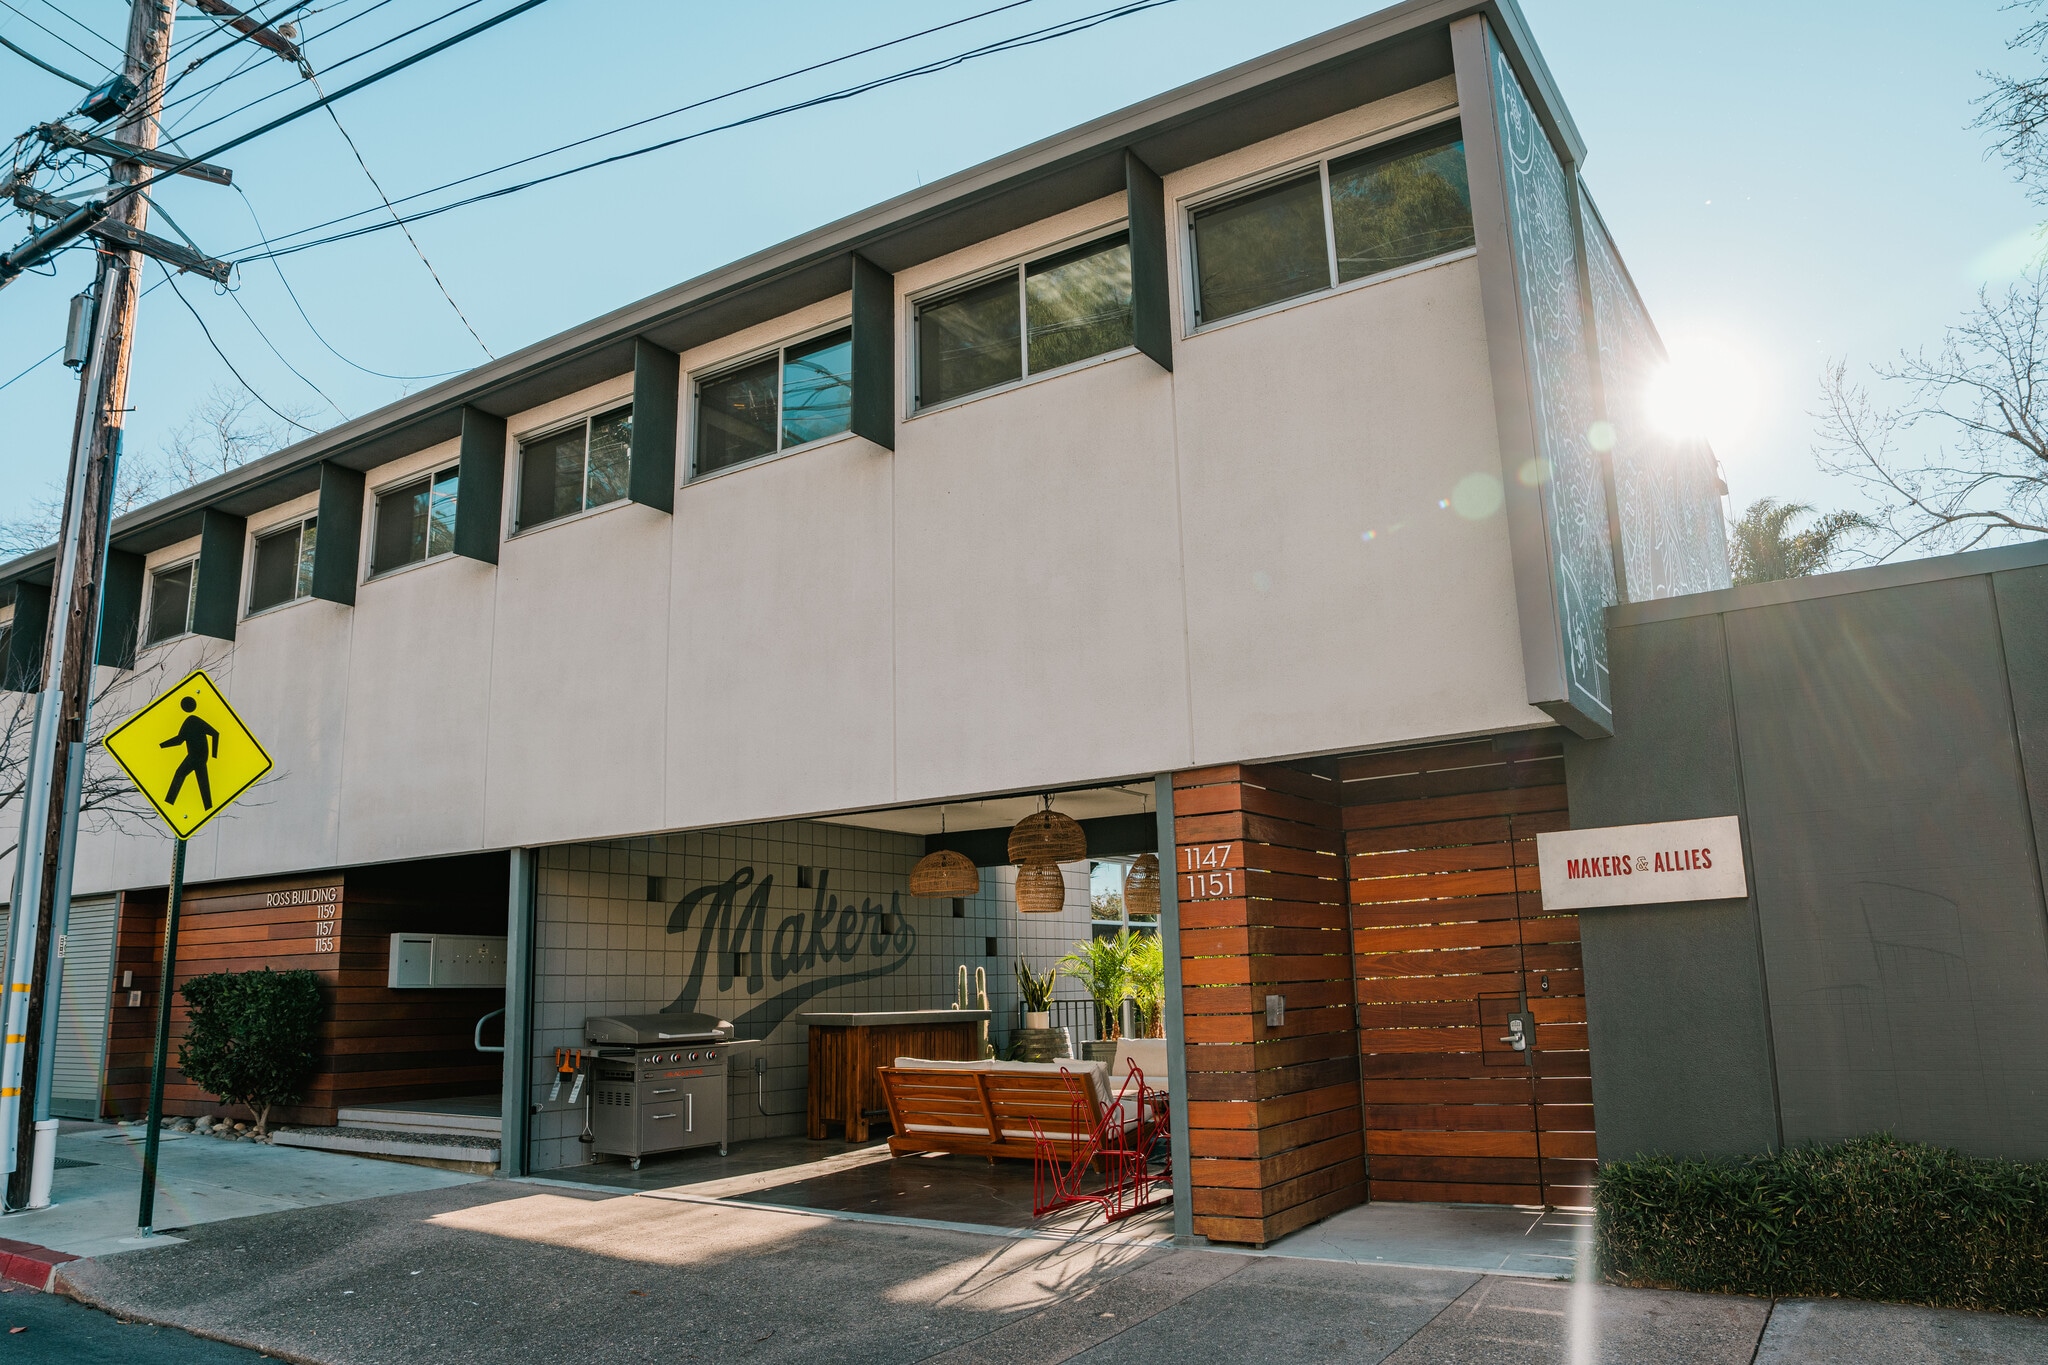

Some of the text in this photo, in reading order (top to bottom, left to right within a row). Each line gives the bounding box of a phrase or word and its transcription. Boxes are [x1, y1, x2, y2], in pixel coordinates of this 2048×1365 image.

[1184, 845, 1231, 870] 1147
[1567, 848, 1713, 879] MAKERS & ALLIES
[1187, 873, 1233, 897] 1151
[267, 888, 336, 906] ROSS BUILDING
[317, 904, 335, 918] 1159
[316, 921, 334, 935] 1157
[315, 938, 333, 952] 1155
[659, 866, 916, 1014] Makers
